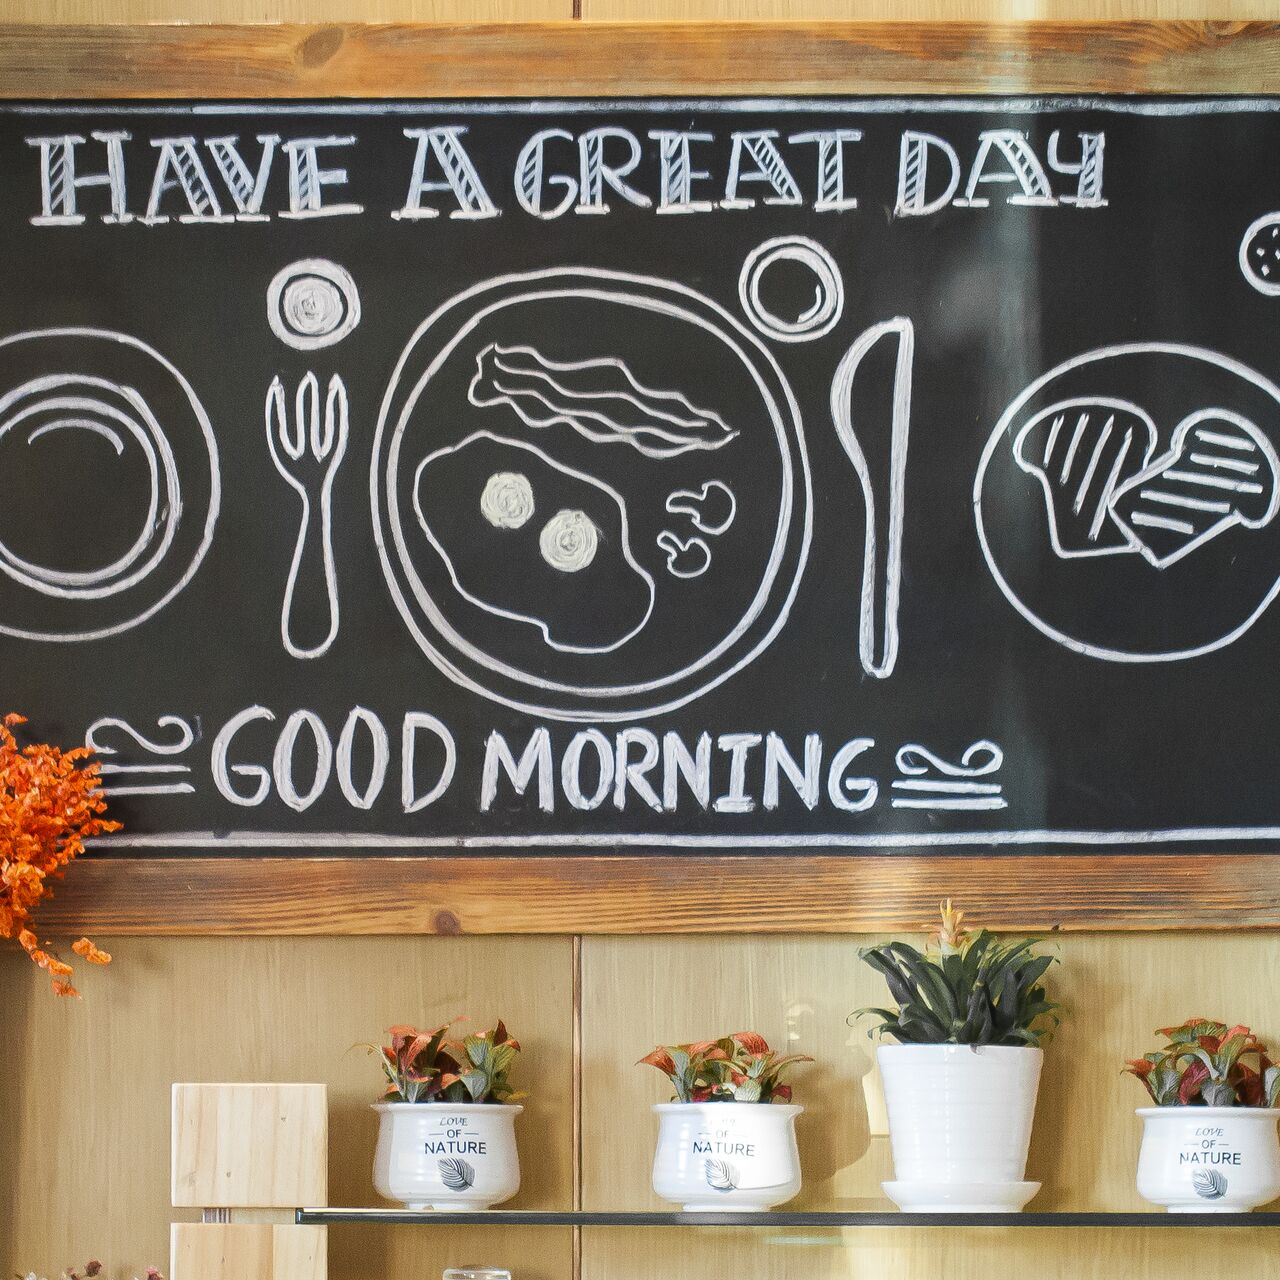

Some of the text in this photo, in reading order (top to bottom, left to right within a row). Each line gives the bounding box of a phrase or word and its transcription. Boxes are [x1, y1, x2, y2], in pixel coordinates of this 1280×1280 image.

[24, 126, 1109, 226] HAVE A GREAT DAY
[210, 705, 879, 813] GOOD MORNING
[439, 1116, 468, 1127] LOVE
[446, 1129, 461, 1139] OF
[424, 1141, 486, 1155] NATURE
[692, 1141, 755, 1157] NATURE
[1201, 1139, 1216, 1149] OF
[1179, 1151, 1241, 1166] NATURE
